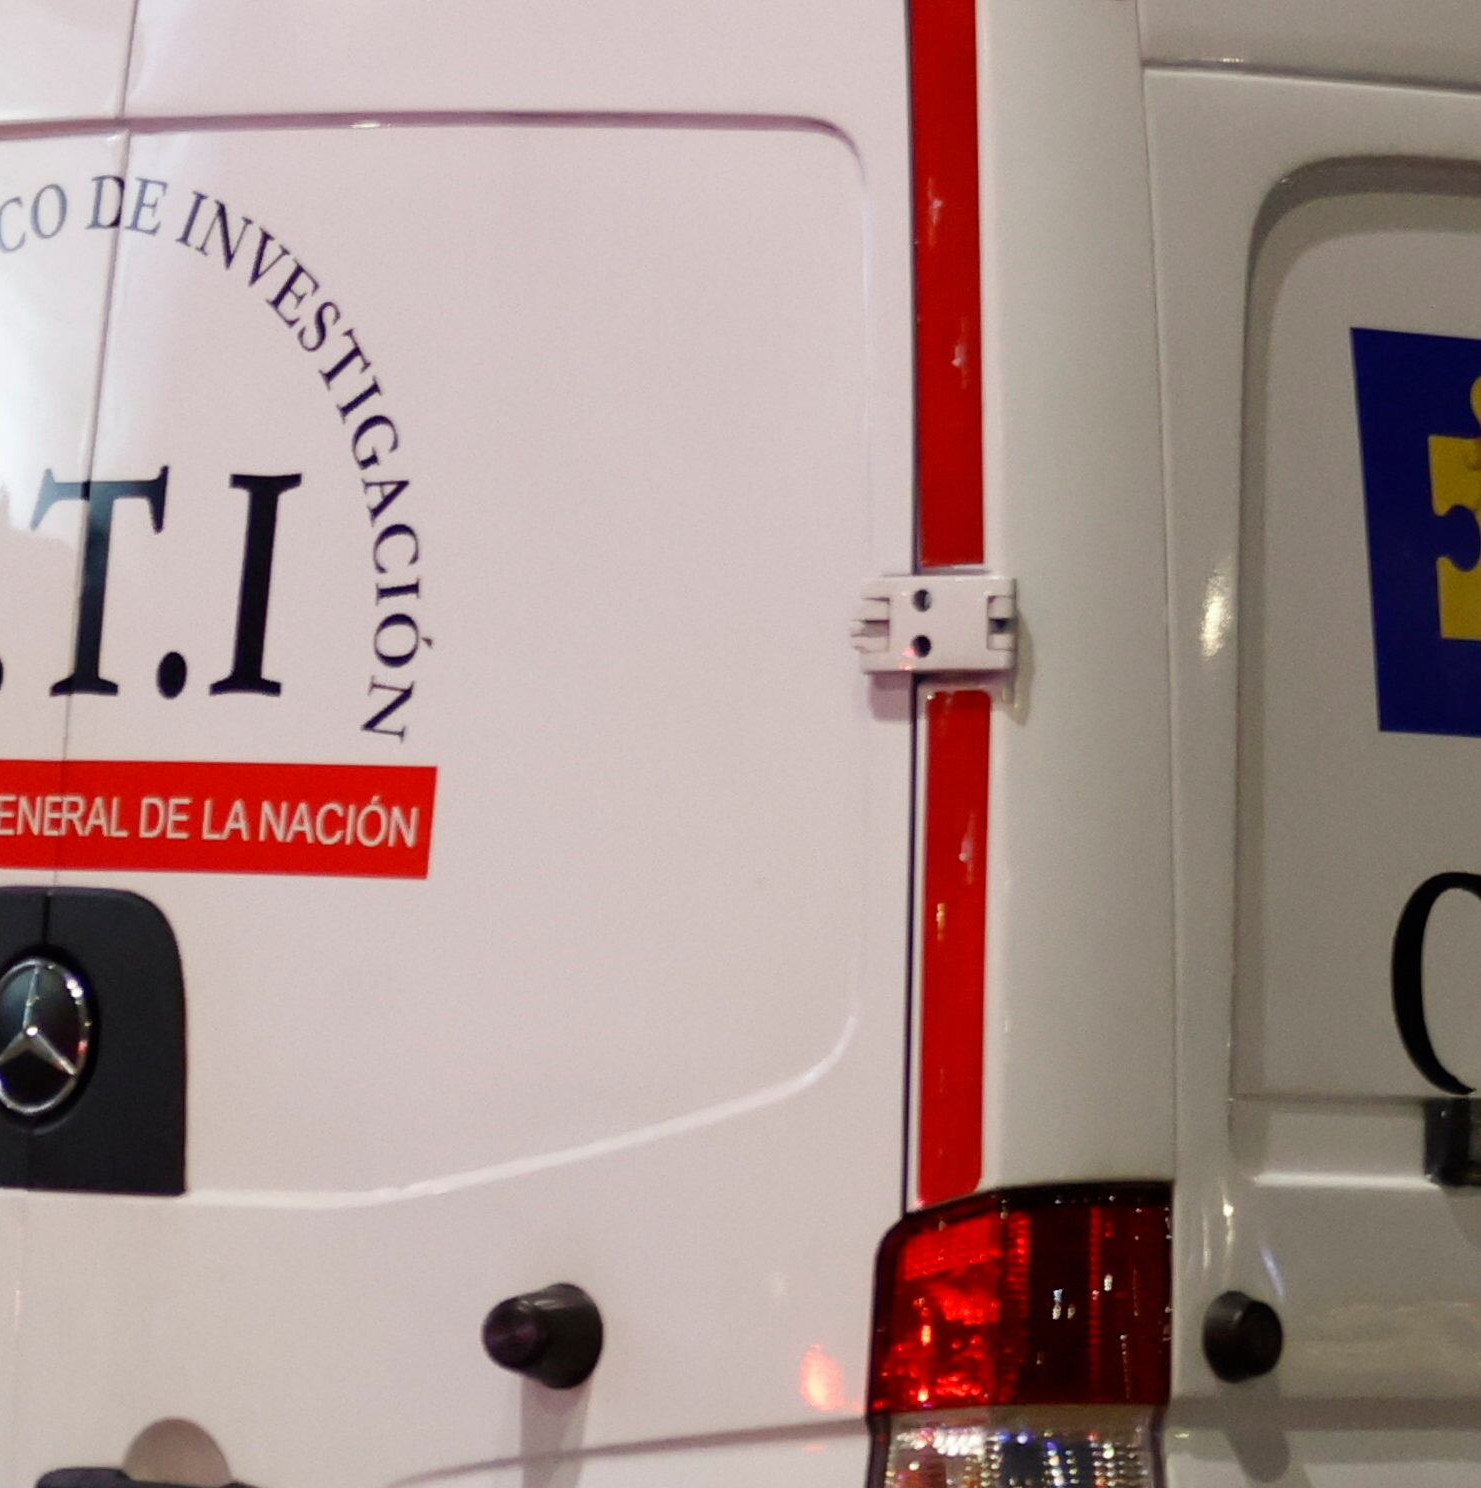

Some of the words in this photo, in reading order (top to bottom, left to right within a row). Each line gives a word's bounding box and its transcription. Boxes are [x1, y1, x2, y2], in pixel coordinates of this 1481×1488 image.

[86, 173, 168, 236] DE
[175, 190, 434, 743] INVESTIGACIÓN
[139, 797, 191, 839] DE
[202, 799, 249, 842] LA
[259, 795, 419, 848] NACIÓN
